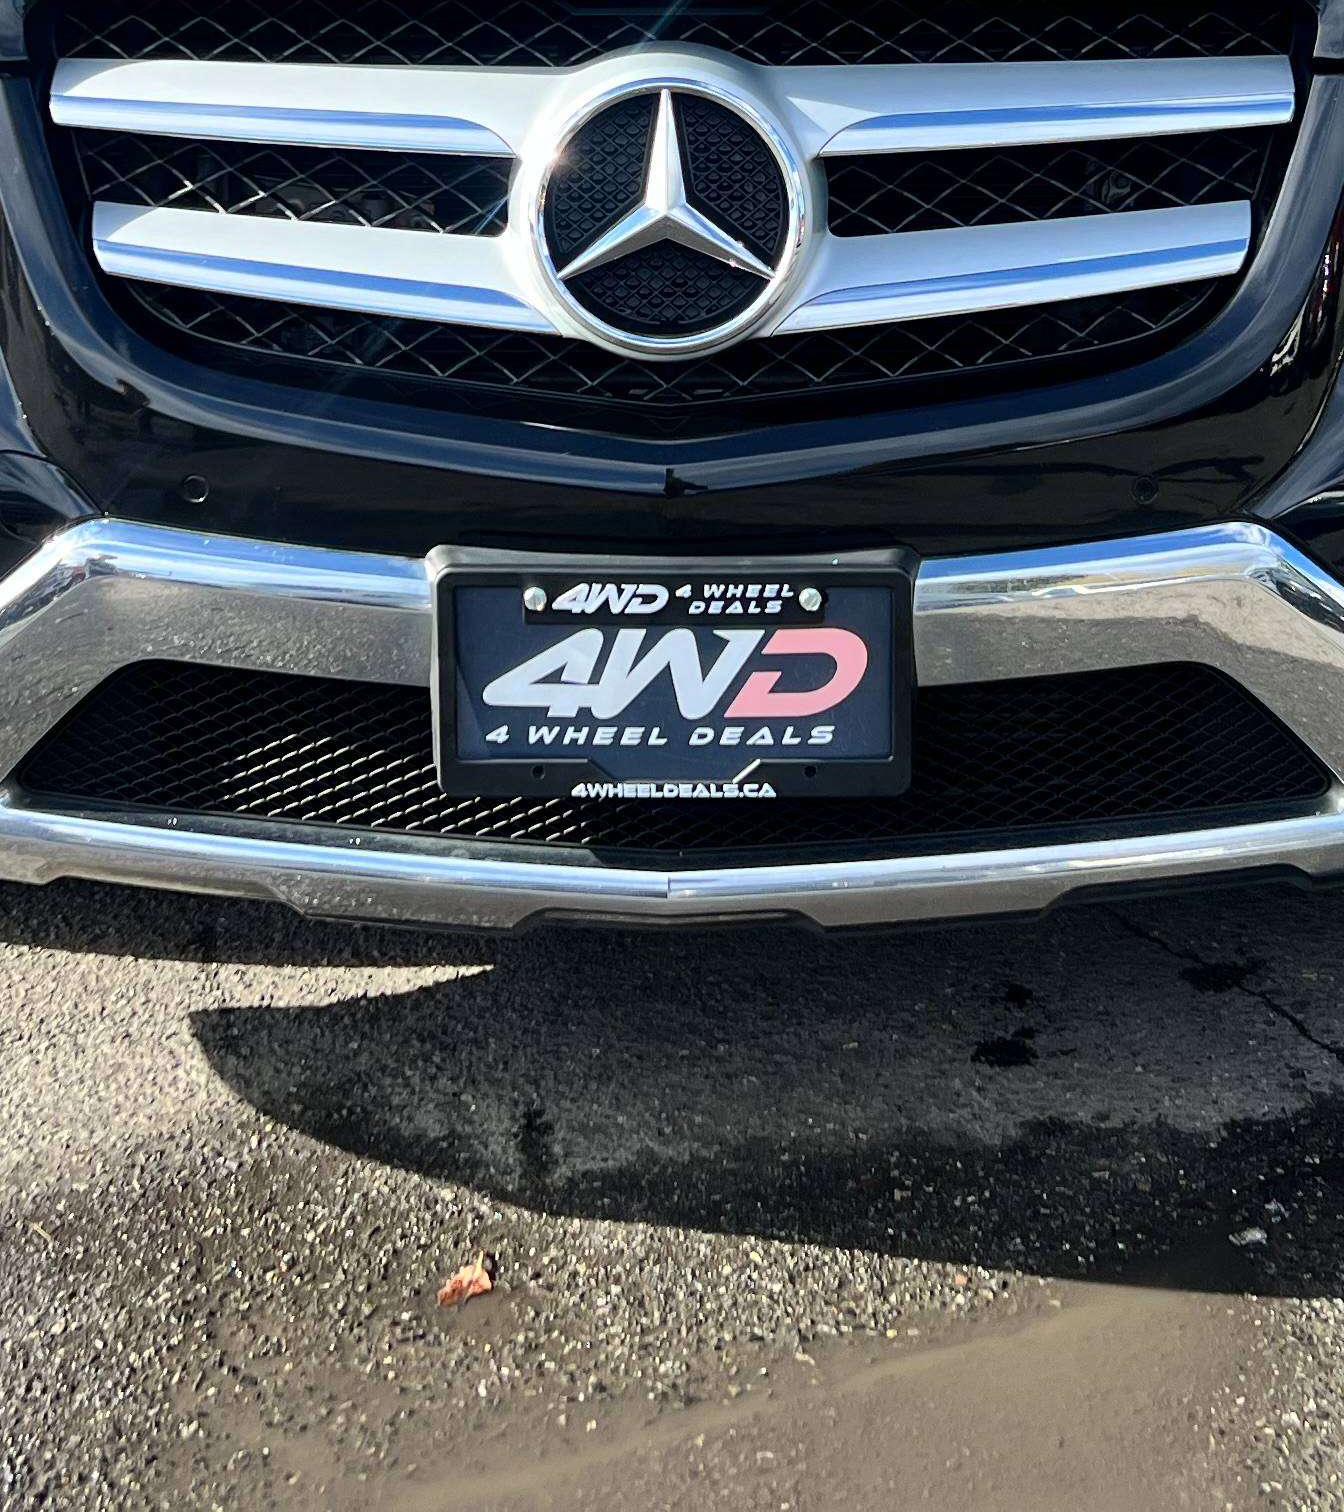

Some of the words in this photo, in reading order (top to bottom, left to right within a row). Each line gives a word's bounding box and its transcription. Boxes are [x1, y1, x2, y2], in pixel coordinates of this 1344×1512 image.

[551, 582, 670, 615] 4WD
[675, 584, 692, 599] 4
[703, 583, 794, 599] WHEEL
[688, 600, 783, 615] DEALS
[482, 627, 868, 720] 4WD
[485, 725, 510, 744] 4
[528, 725, 668, 746] WHEEL
[688, 725, 835, 746] DEALS
[571, 783, 777, 799] 4WHEELDEALS.CA
